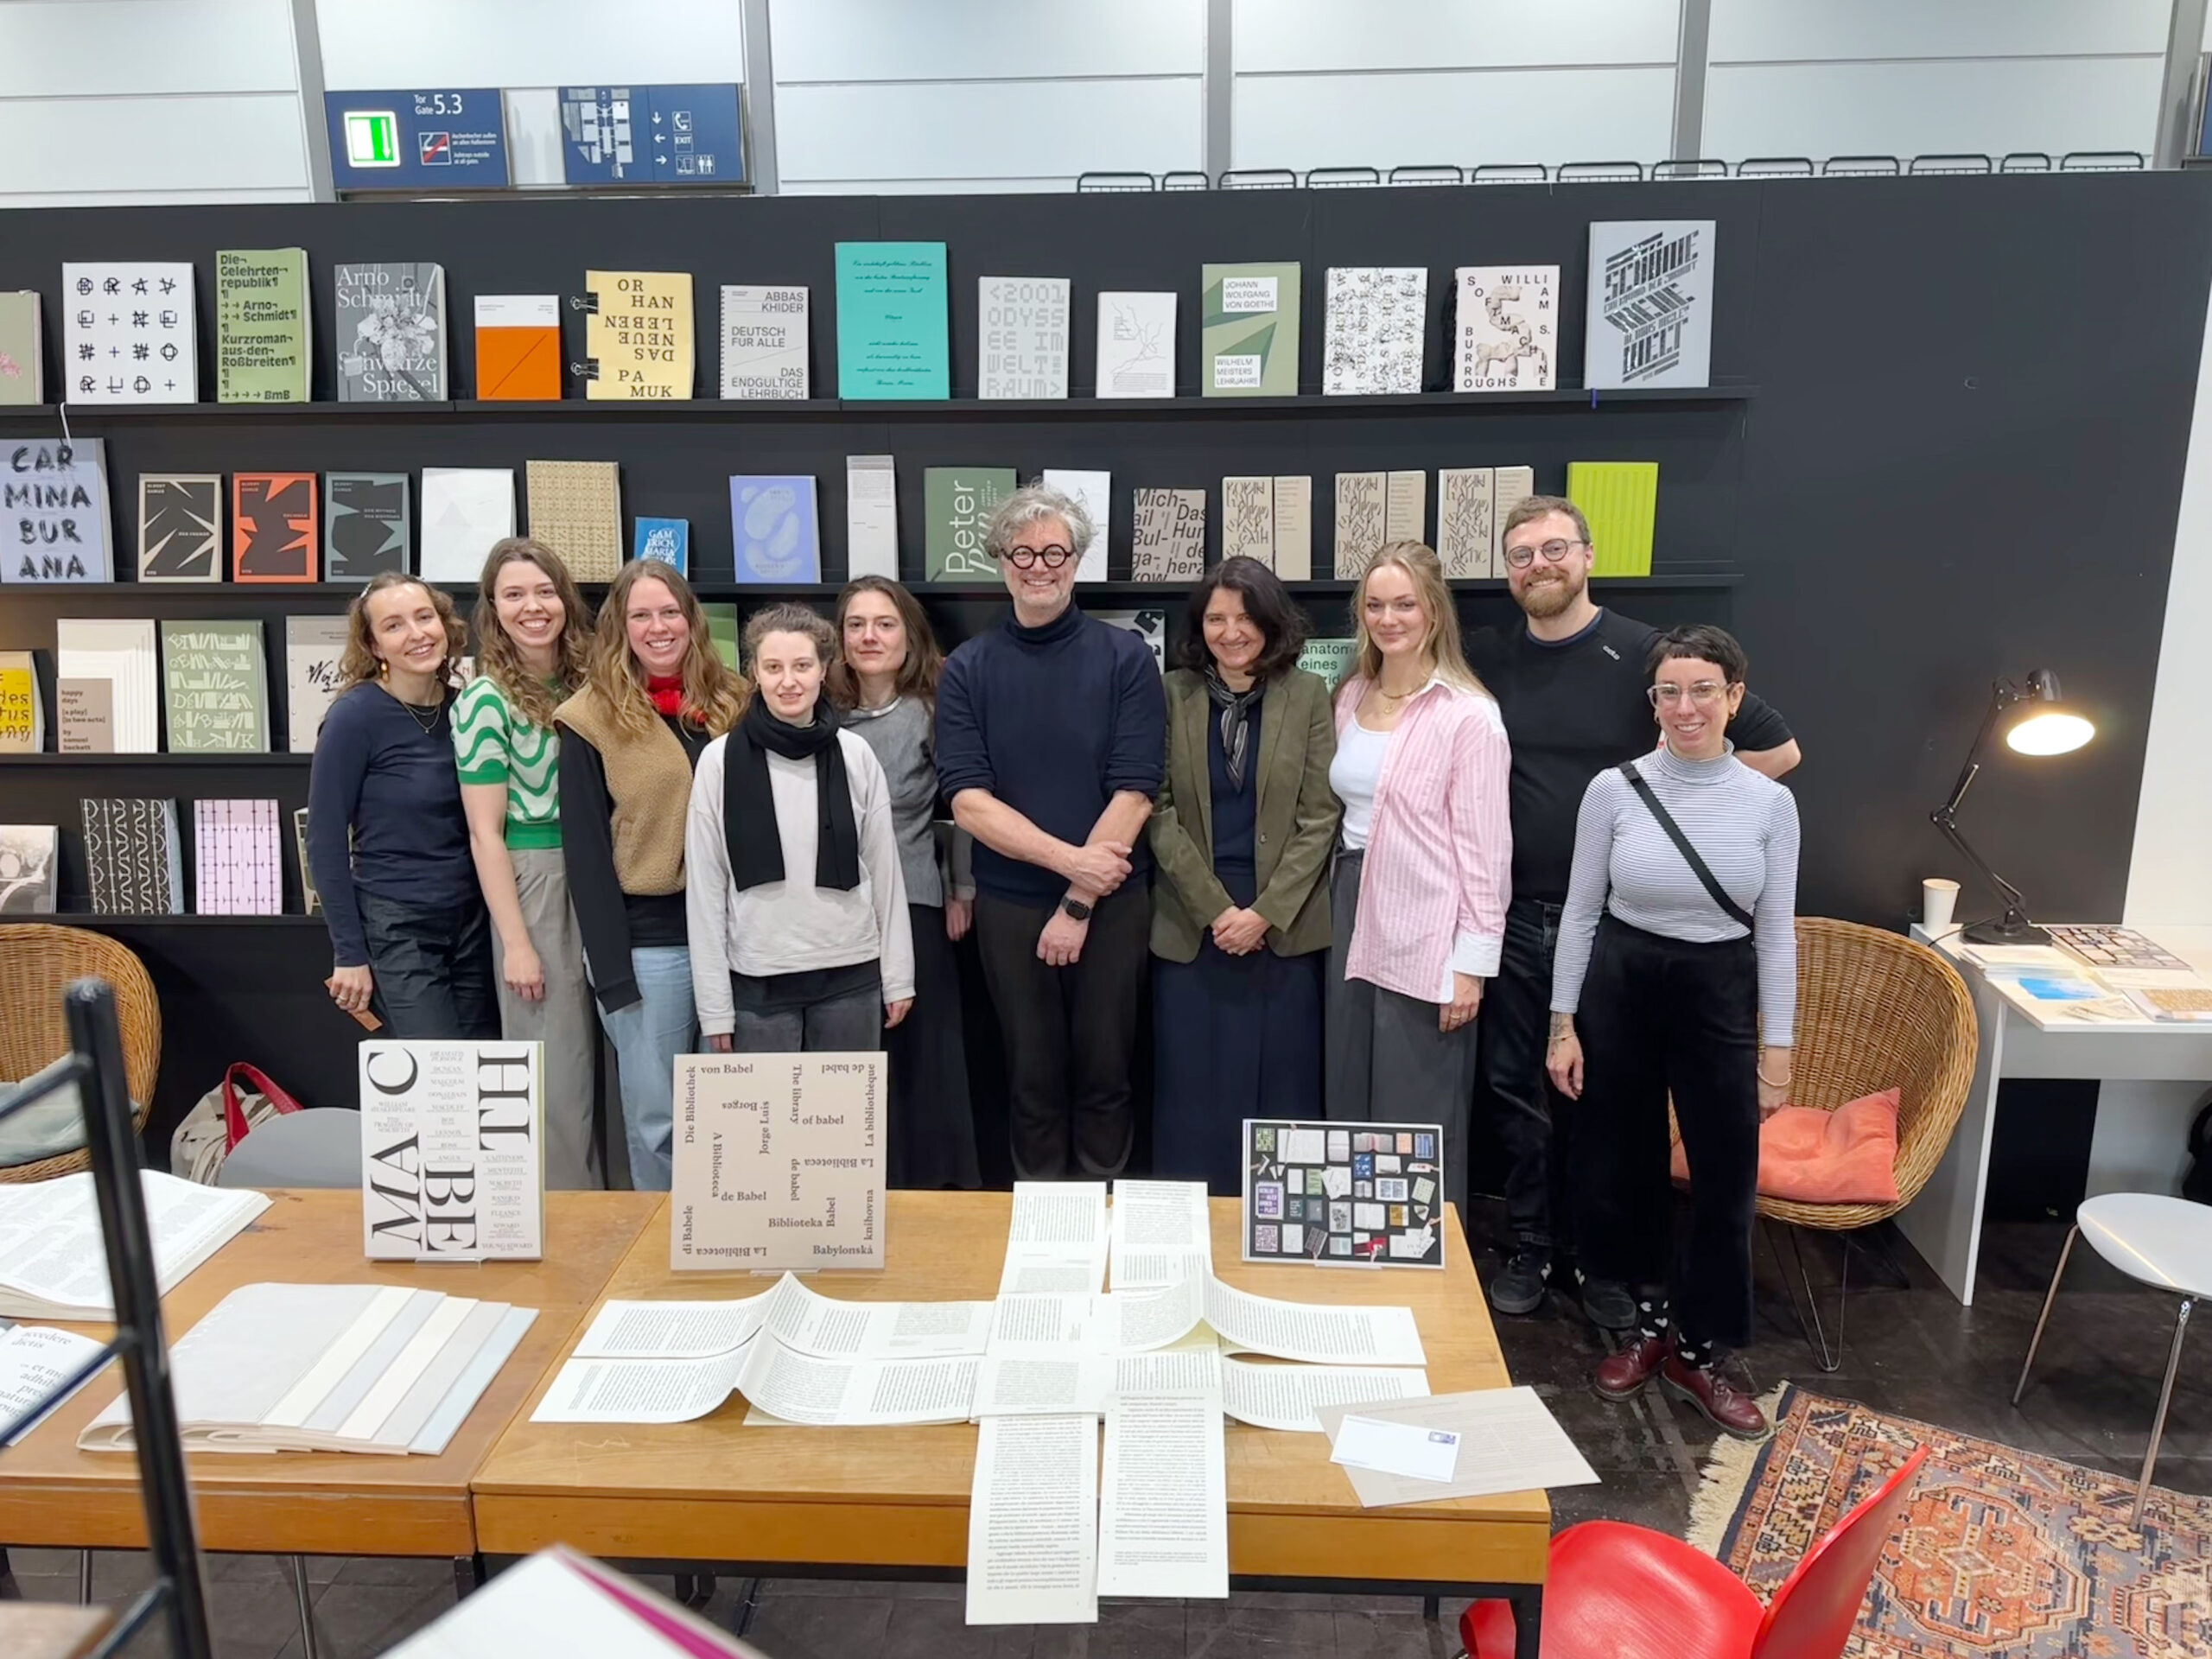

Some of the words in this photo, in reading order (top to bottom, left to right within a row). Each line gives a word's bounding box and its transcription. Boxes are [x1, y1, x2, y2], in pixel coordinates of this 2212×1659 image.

[414, 94, 427, 104] Tor
[434, 93, 463, 114] 5.3
[415, 105, 434, 115] Gate
[676, 136, 691, 144] EXIT
[337, 268, 389, 287] Arno
[618, 278, 644, 292] OR
[765, 292, 804, 302] ABBAS
[1225, 290, 1270, 299] WOLFGANG
[631, 296, 674, 309] HAN
[762, 302, 804, 313] KHIDER
[1225, 301, 1242, 309] VON
[1243, 299, 1274, 308] GOETHE
[605, 315, 673, 330] LEBEN
[987, 307, 1065, 327] ODYSS
[731, 327, 786, 337] DEUTSCH
[619, 332, 675, 346] NEUE
[757, 337, 785, 347] ALLE
[634, 347, 675, 361] DAS
[1217, 358, 1253, 366] WILHELM
[619, 370, 645, 382] PA
[781, 368, 804, 378] DAS
[1217, 377, 1258, 385] LEHRJAHRE
[630, 385, 672, 397] MUK
[741, 389, 804, 397] LEHRBUCH
[11, 444, 75, 473] CAR
[3, 482, 92, 508] MINA
[19, 518, 83, 545] BUR
[945, 480, 975, 573] Peter
[19, 554, 86, 581] ANA
[1301, 658, 1338, 671] eines
[724, 1064, 753, 1074] Babel
[793, 1065, 802, 1084] The
[822, 1065, 849, 1074] babel
[852, 1065, 864, 1073] de
[685, 1065, 696, 1122] Bibliothek
[865, 1065, 878, 1130] bibliothèque
[722, 1101, 758, 1111] Borges
[790, 1089, 802, 1124] library
[760, 1101, 769, 1124] Luis
[802, 1116, 814, 1125] of
[816, 1115, 844, 1125] babel
[685, 1123, 695, 1144] Die
[714, 1132, 722, 1141] A
[759, 1127, 771, 1154] Jorge
[865, 1133, 874, 1147] La
[366, 1047, 423, 1251] MAC
[791, 1159, 800, 1172] de
[804, 1158, 857, 1168] Biblioteca
[861, 1158, 874, 1168] La
[712, 1142, 722, 1198] Biblioteca
[791, 1173, 800, 1201] babel
[721, 1192, 734, 1201] de
[737, 1192, 766, 1201] Babel
[826, 1197, 836, 1227] Babel
[864, 1189, 874, 1241] knihovna
[683, 1205, 693, 1241] Babele
[769, 1218, 823, 1227] Biblioteka
[683, 1243, 692, 1255] di
[696, 1248, 750, 1256] Biblioteca
[754, 1248, 767, 1256] La
[813, 1244, 873, 1256] Babylonská
